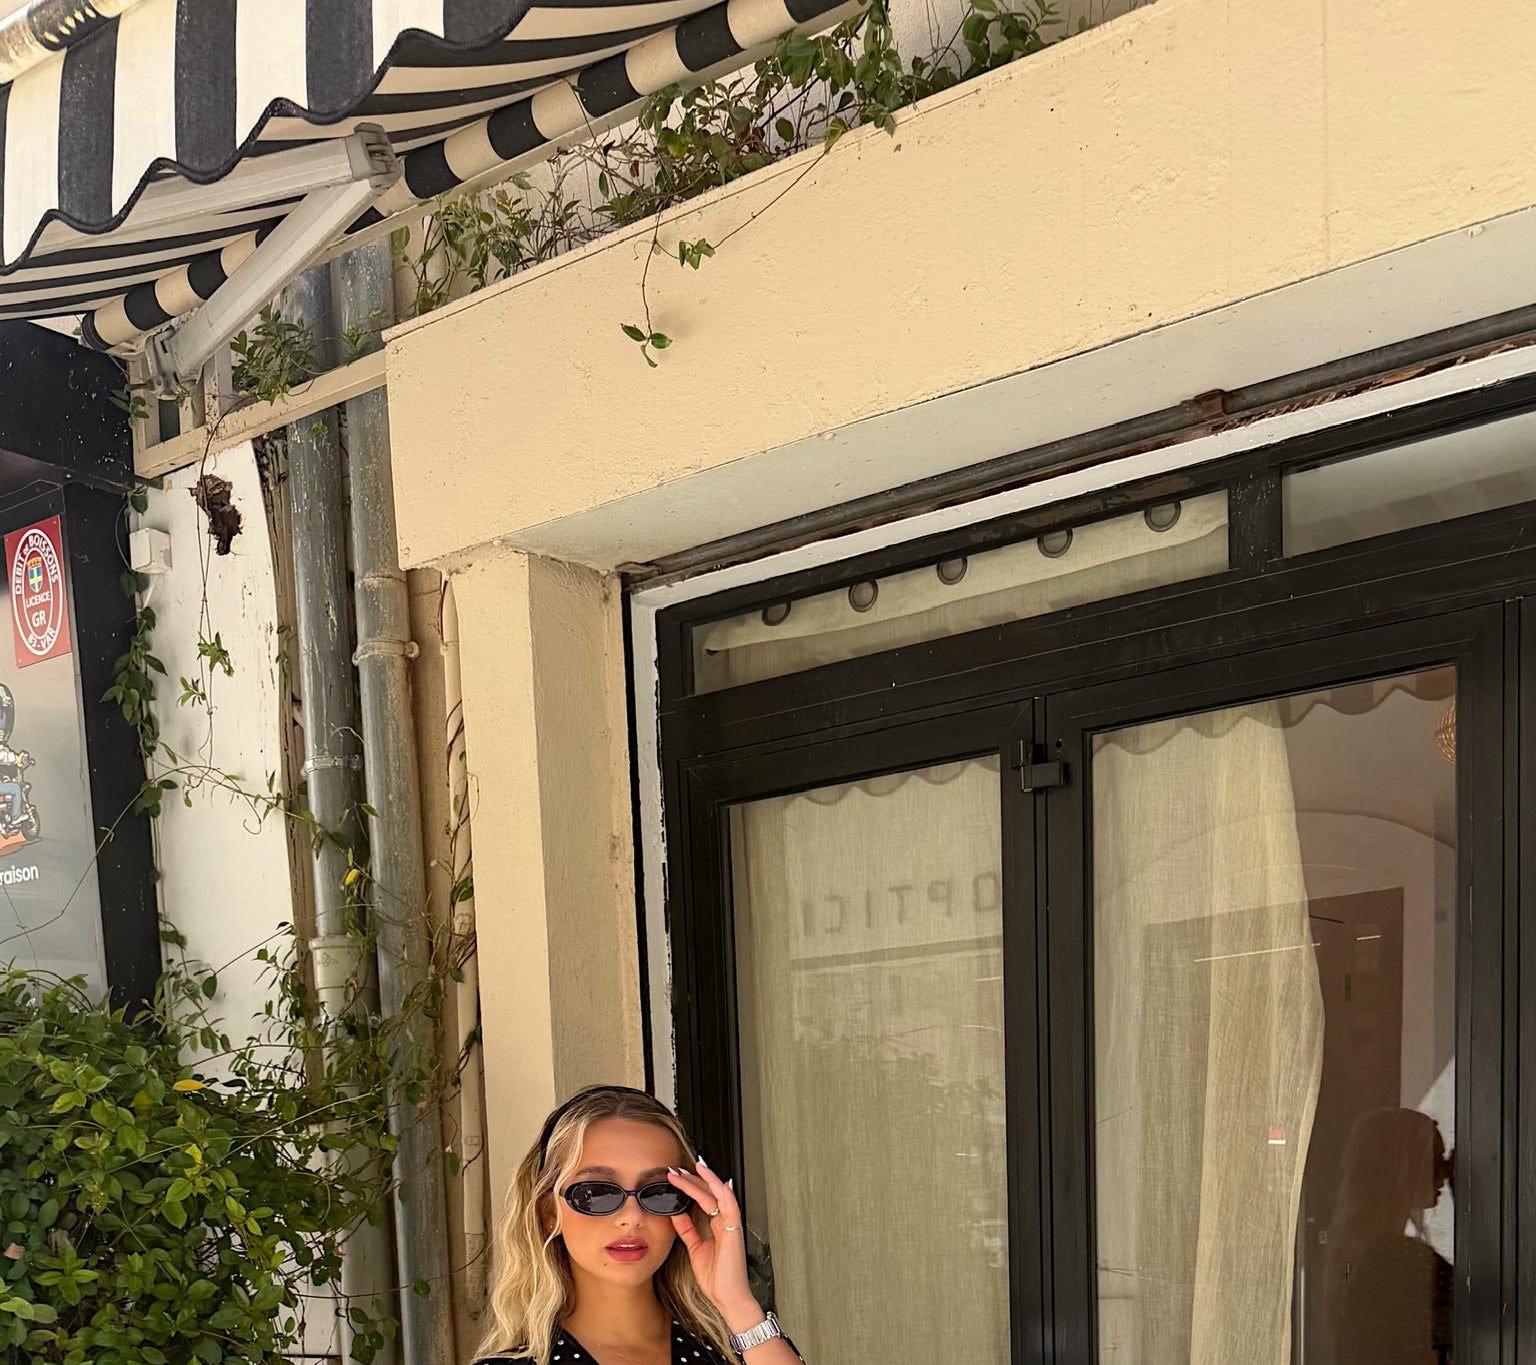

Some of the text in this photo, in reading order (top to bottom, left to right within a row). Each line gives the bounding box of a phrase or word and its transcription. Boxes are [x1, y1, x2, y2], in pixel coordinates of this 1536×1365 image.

[28, 534, 59, 583] BOISSONS
[26, 591, 51, 609] LICENCE
[32, 610, 47, 627] GR
